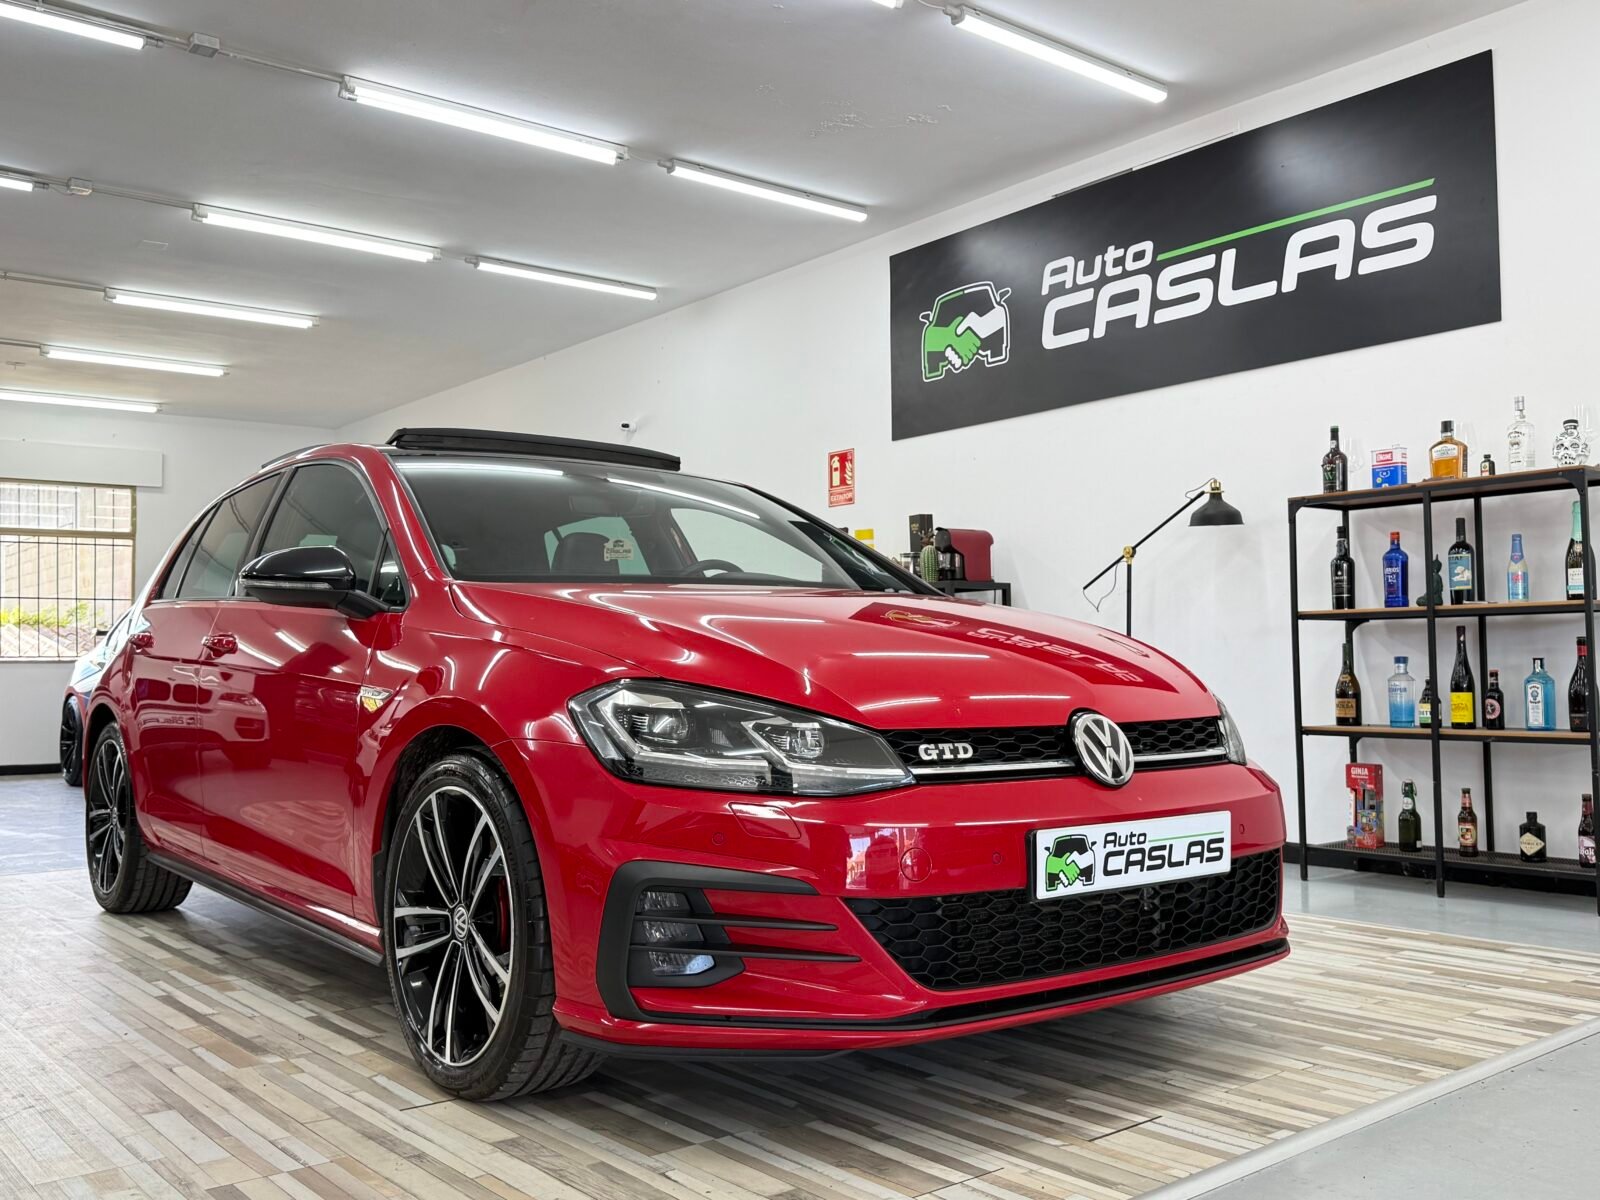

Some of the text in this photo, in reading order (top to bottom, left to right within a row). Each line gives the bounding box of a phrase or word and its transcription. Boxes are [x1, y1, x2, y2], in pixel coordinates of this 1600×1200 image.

[1041, 240, 1154, 295] Auto
[1041, 194, 1437, 350] CASLAS
[918, 742, 974, 761] GTD
[1350, 767, 1369, 775] GINJA
[1103, 831, 1147, 849] Auto
[1102, 837, 1225, 877] CASLAS
